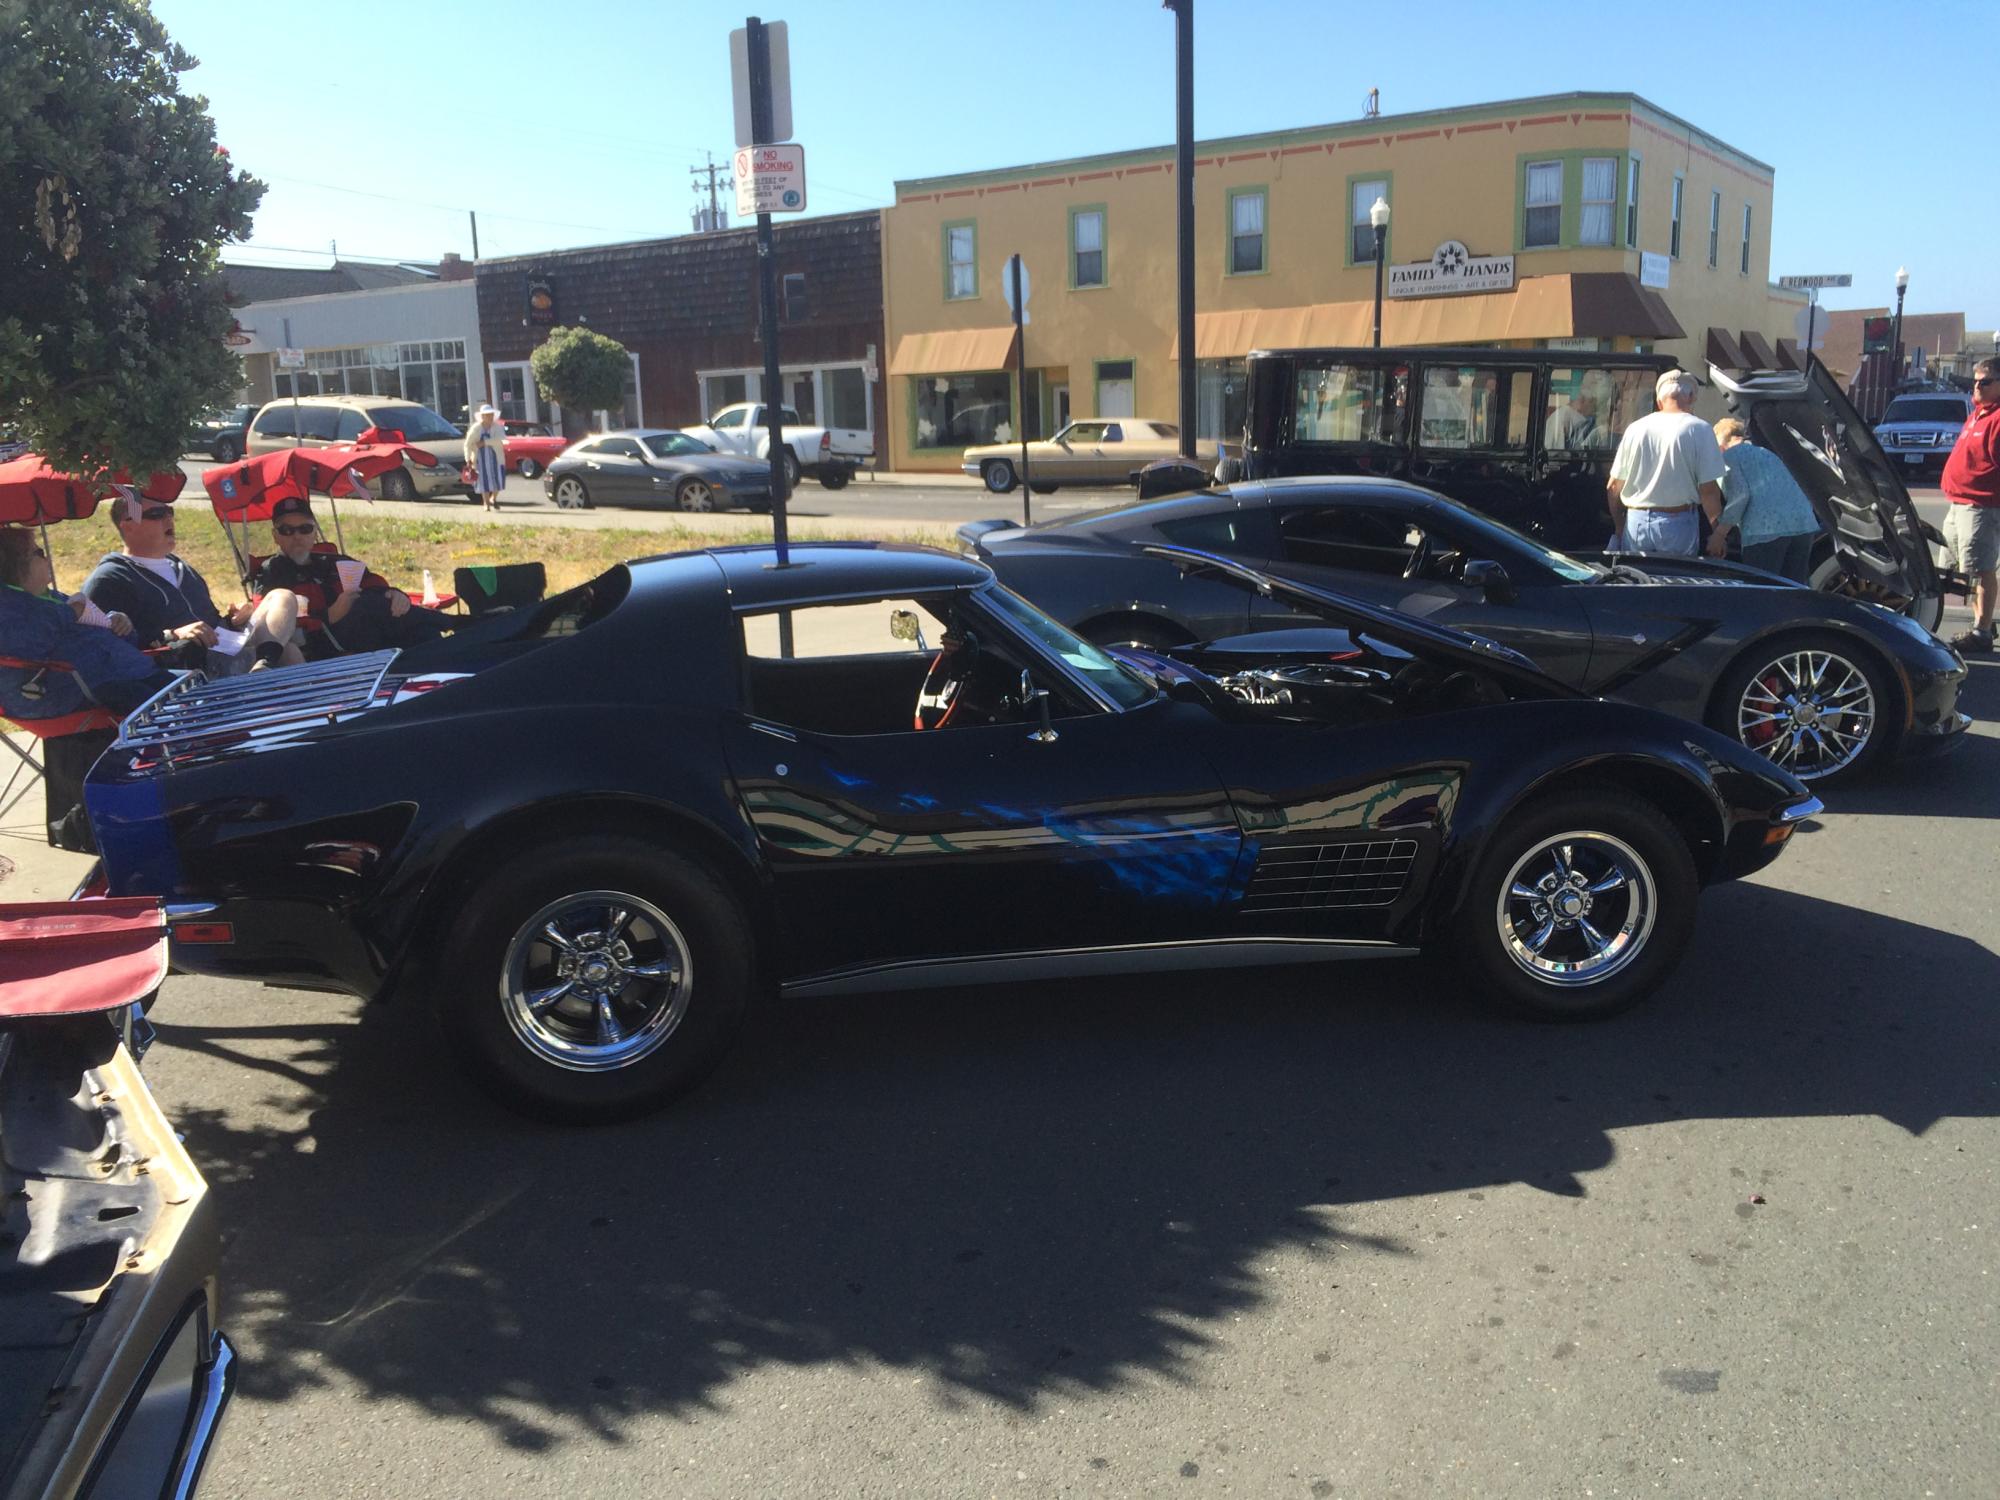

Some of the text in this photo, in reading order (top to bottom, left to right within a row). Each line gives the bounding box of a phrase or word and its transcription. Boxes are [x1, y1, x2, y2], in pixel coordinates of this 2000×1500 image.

[764, 151, 777, 160] NO
[753, 161, 793, 171] SMOKING
[1392, 263, 1511, 283] FAMILY HANDS
[1788, 276, 1824, 288] REDWOOD
